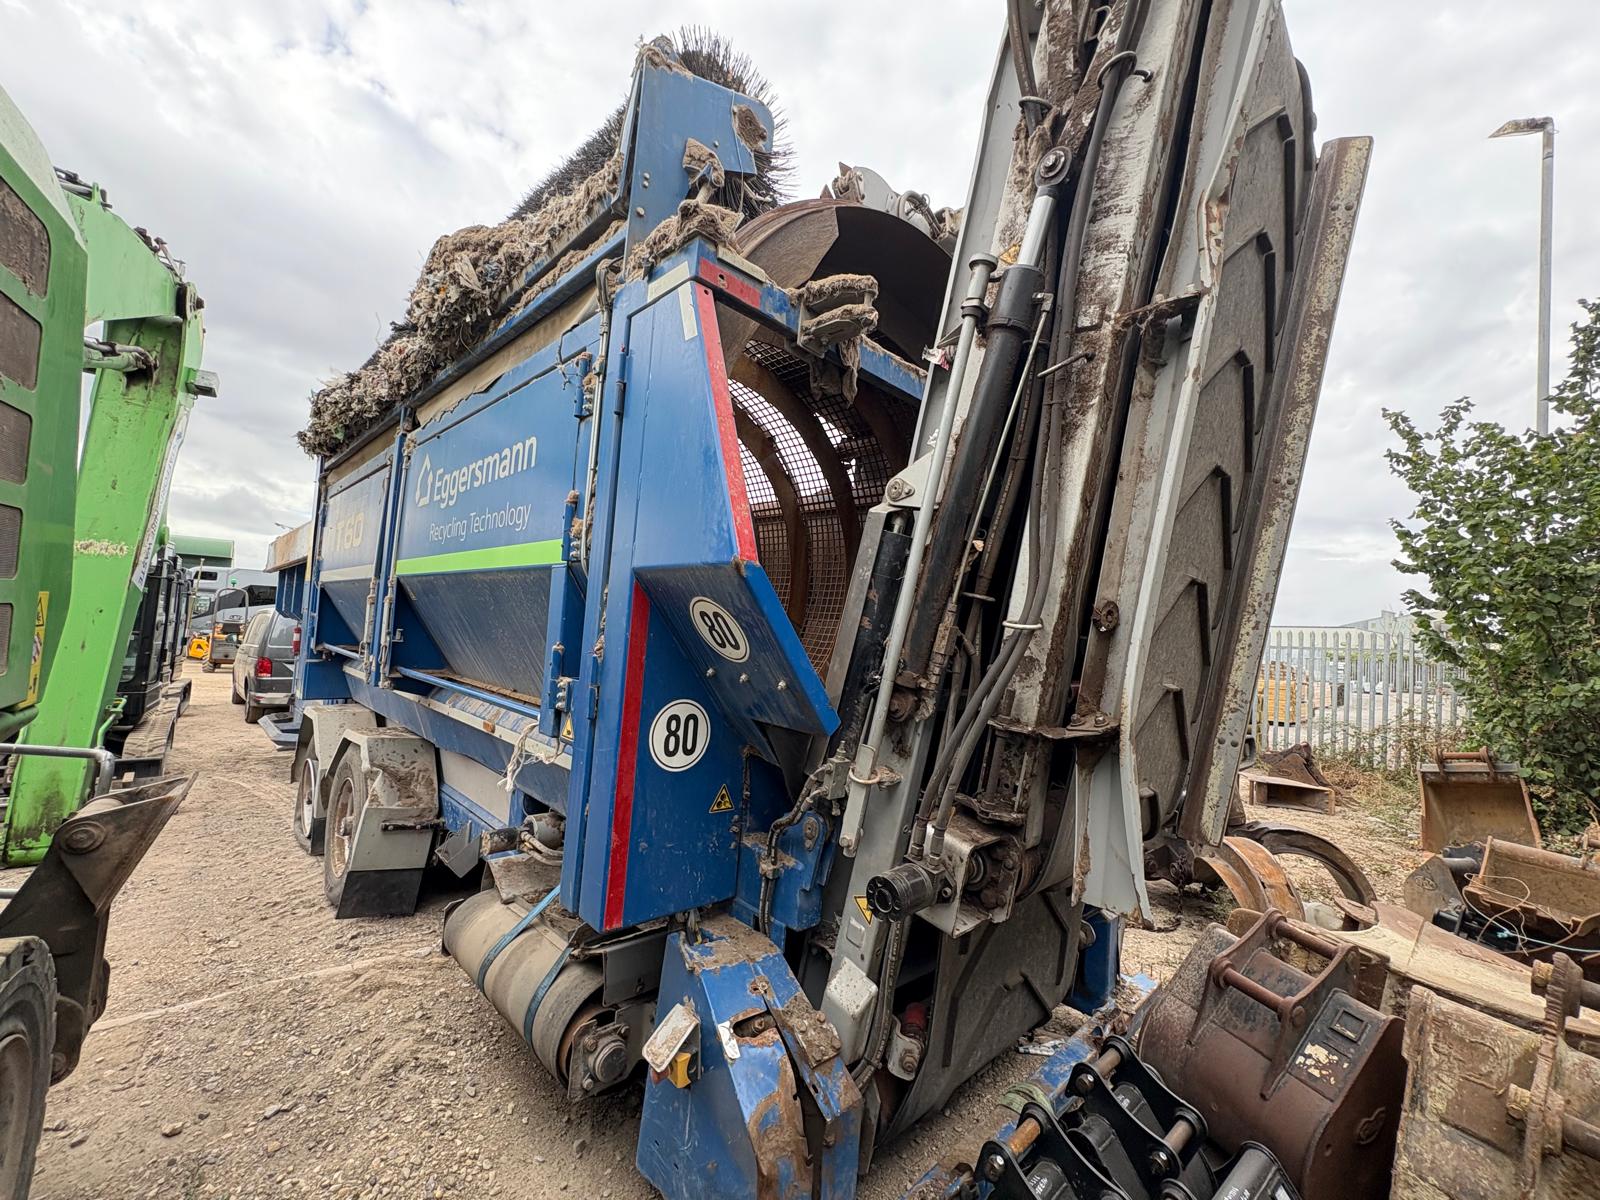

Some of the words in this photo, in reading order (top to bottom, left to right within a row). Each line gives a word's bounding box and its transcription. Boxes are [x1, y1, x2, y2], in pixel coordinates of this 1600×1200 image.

[433, 436, 537, 509] Eggersmann
[429, 516, 467, 544] Recycling
[469, 501, 532, 531] Technology
[700, 610, 740, 651] 80
[663, 713, 699, 757] 80
